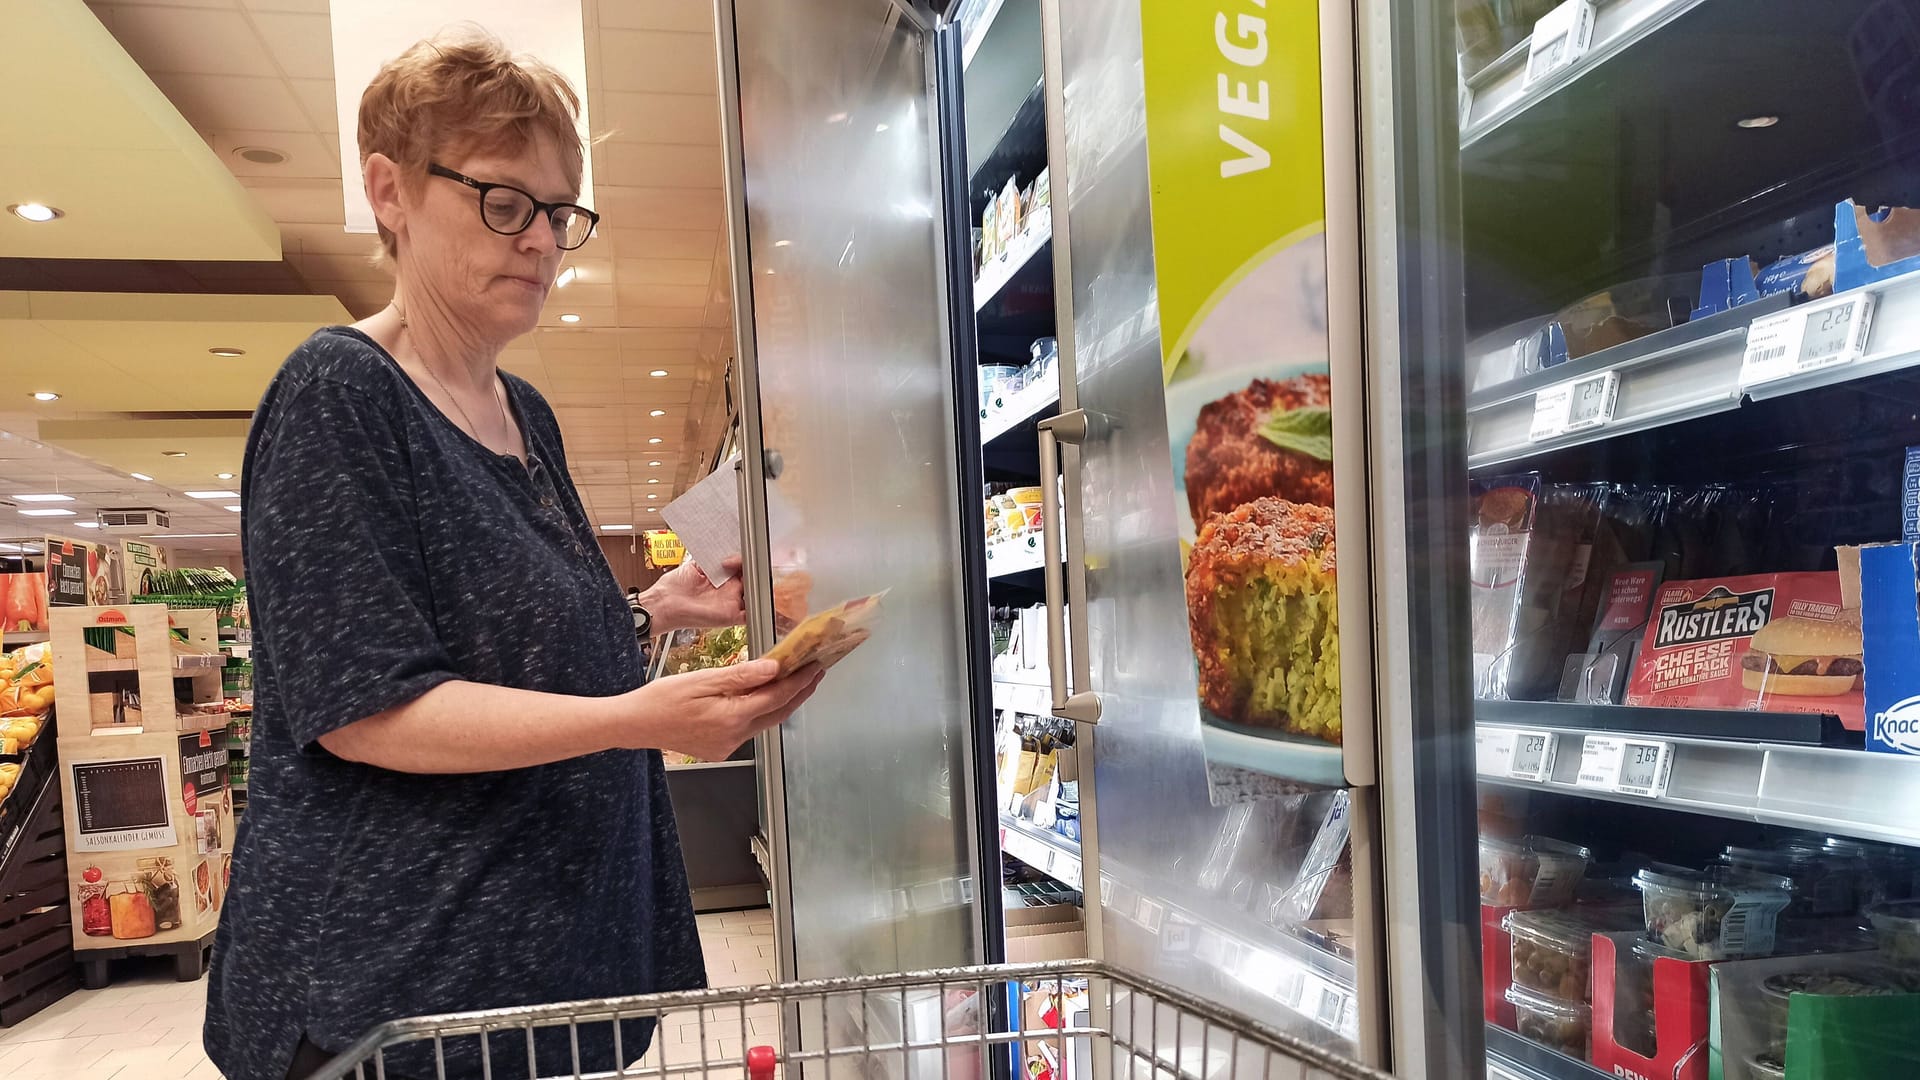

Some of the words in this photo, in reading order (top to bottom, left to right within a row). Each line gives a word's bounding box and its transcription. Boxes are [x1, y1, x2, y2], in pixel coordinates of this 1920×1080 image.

[1214, 0, 1272, 179] VEG
[1821, 304, 1853, 332] 2.29
[654, 540, 665, 549] AUS
[1659, 594, 1769, 644] RUSTLERS
[1655, 640, 1734, 671] CHEESE
[1656, 665, 1689, 682] TWIN
[1693, 656, 1729, 675] PACK
[1709, 667, 1729, 679] SAUCE
[1876, 715, 1919, 738] Knac
[1636, 747, 1658, 765] 3.69
